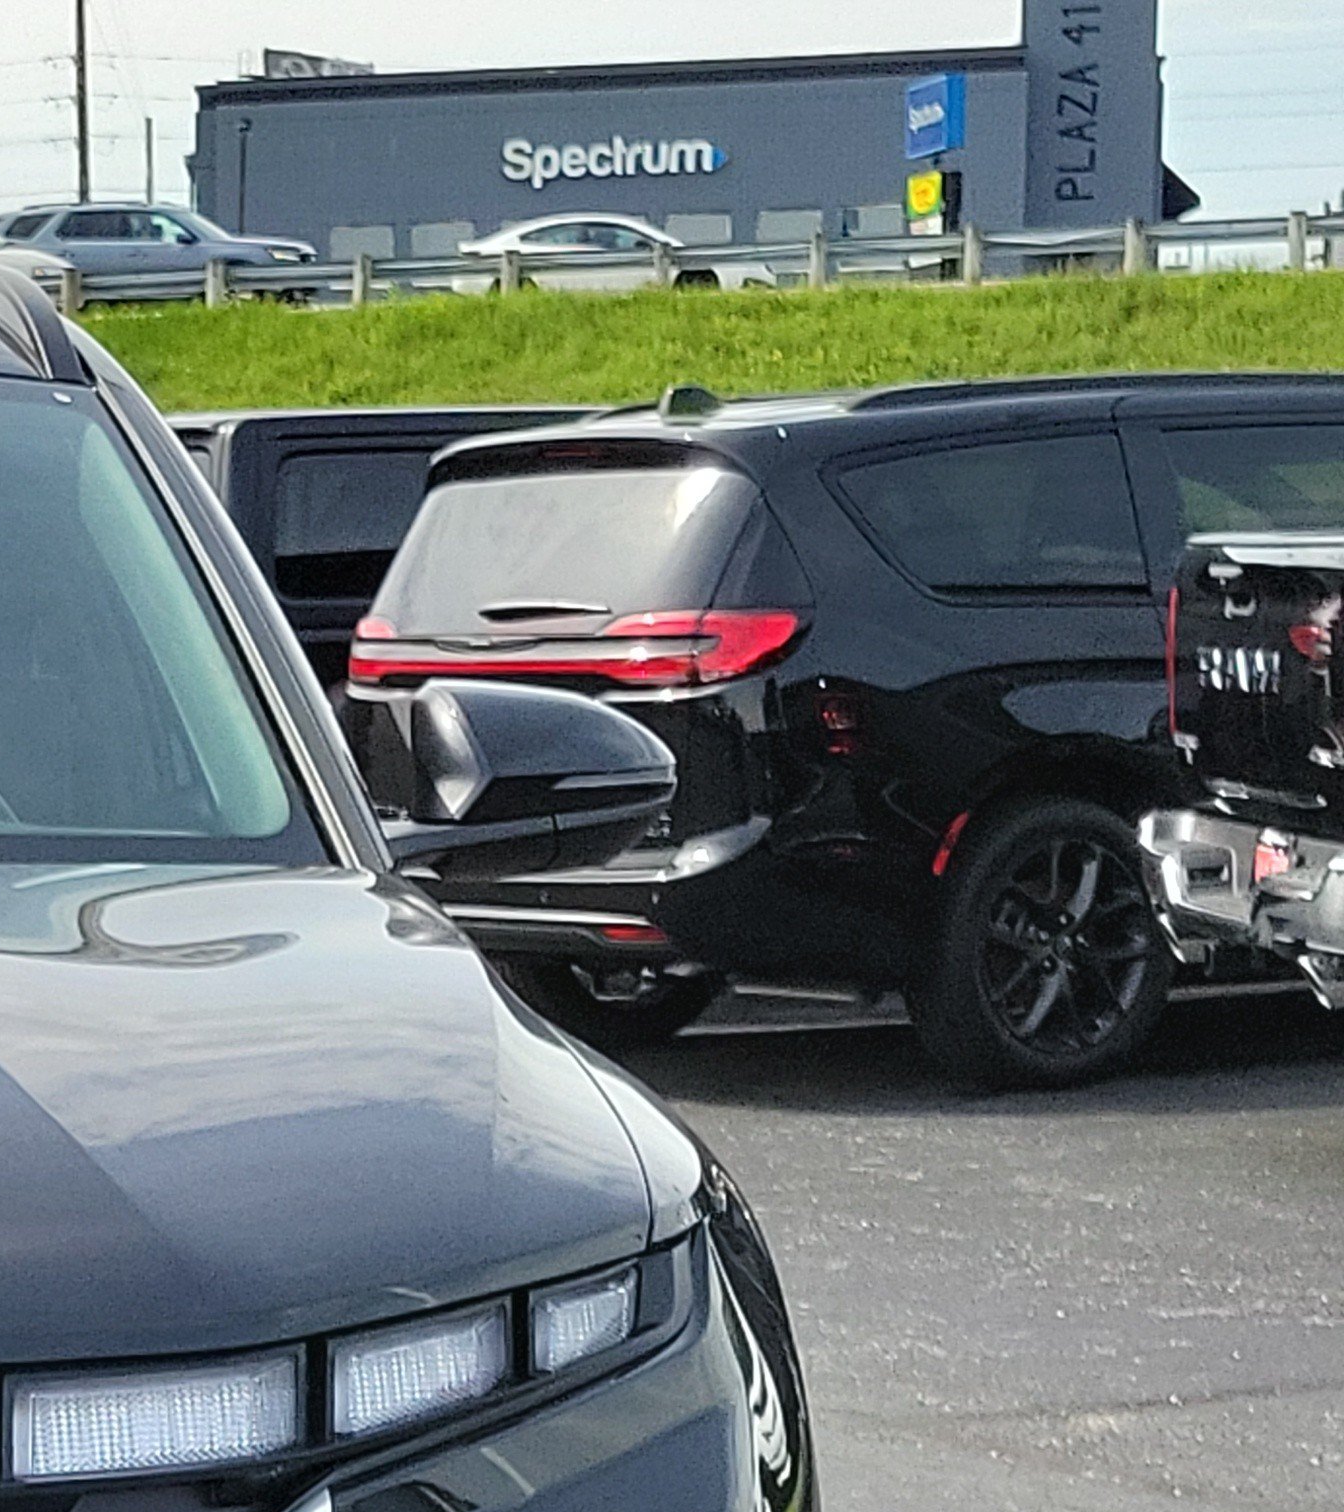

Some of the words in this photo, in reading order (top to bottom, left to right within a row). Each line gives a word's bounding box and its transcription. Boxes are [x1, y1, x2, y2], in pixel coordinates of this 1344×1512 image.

[1062, 6, 1102, 44] 41
[1055, 63, 1100, 200] PLAZA
[502, 135, 714, 189] Spectrum
